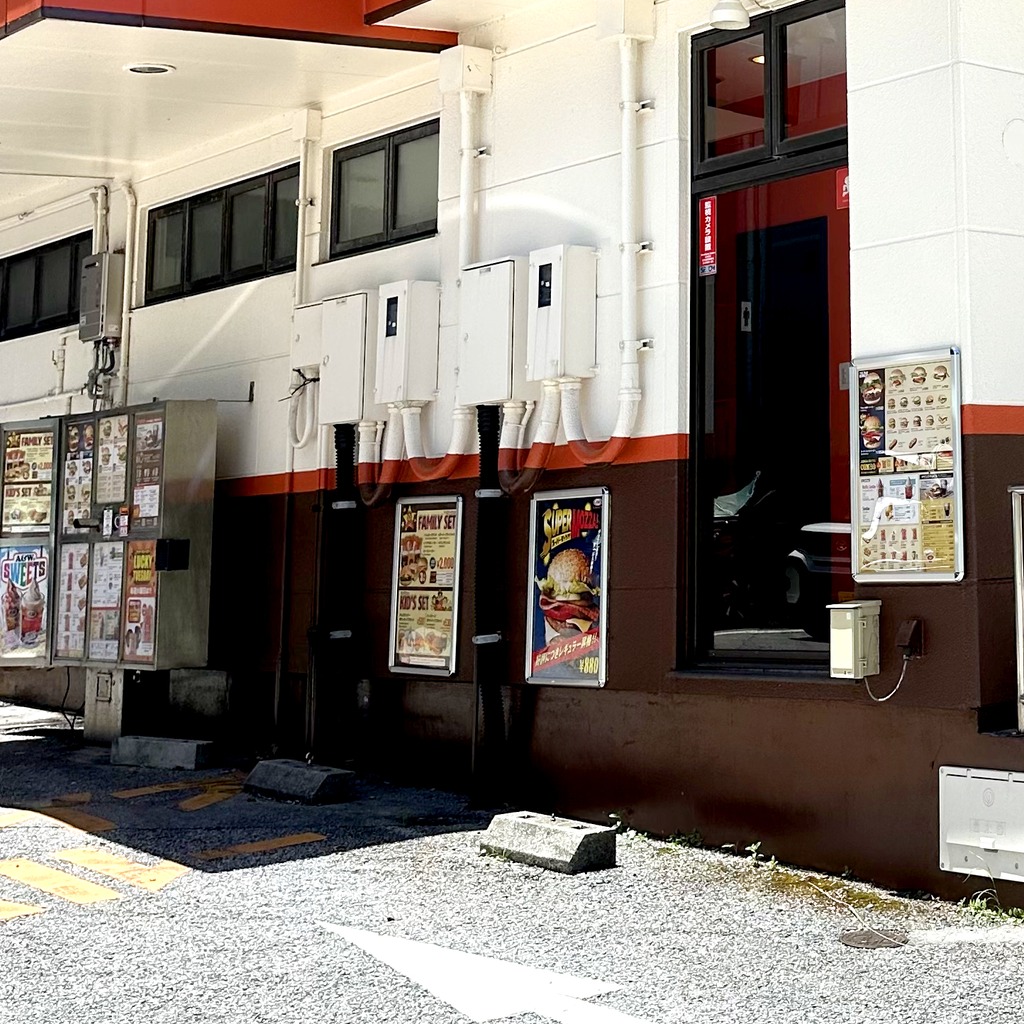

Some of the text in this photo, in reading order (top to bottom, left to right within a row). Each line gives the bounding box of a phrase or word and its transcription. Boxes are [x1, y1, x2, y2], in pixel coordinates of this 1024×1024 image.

[418, 514, 456, 530] FAMILY SET
[542, 508, 572, 547] SUPER
[3, 560, 46, 587] SWEETS
[417, 595, 429, 610] SET
